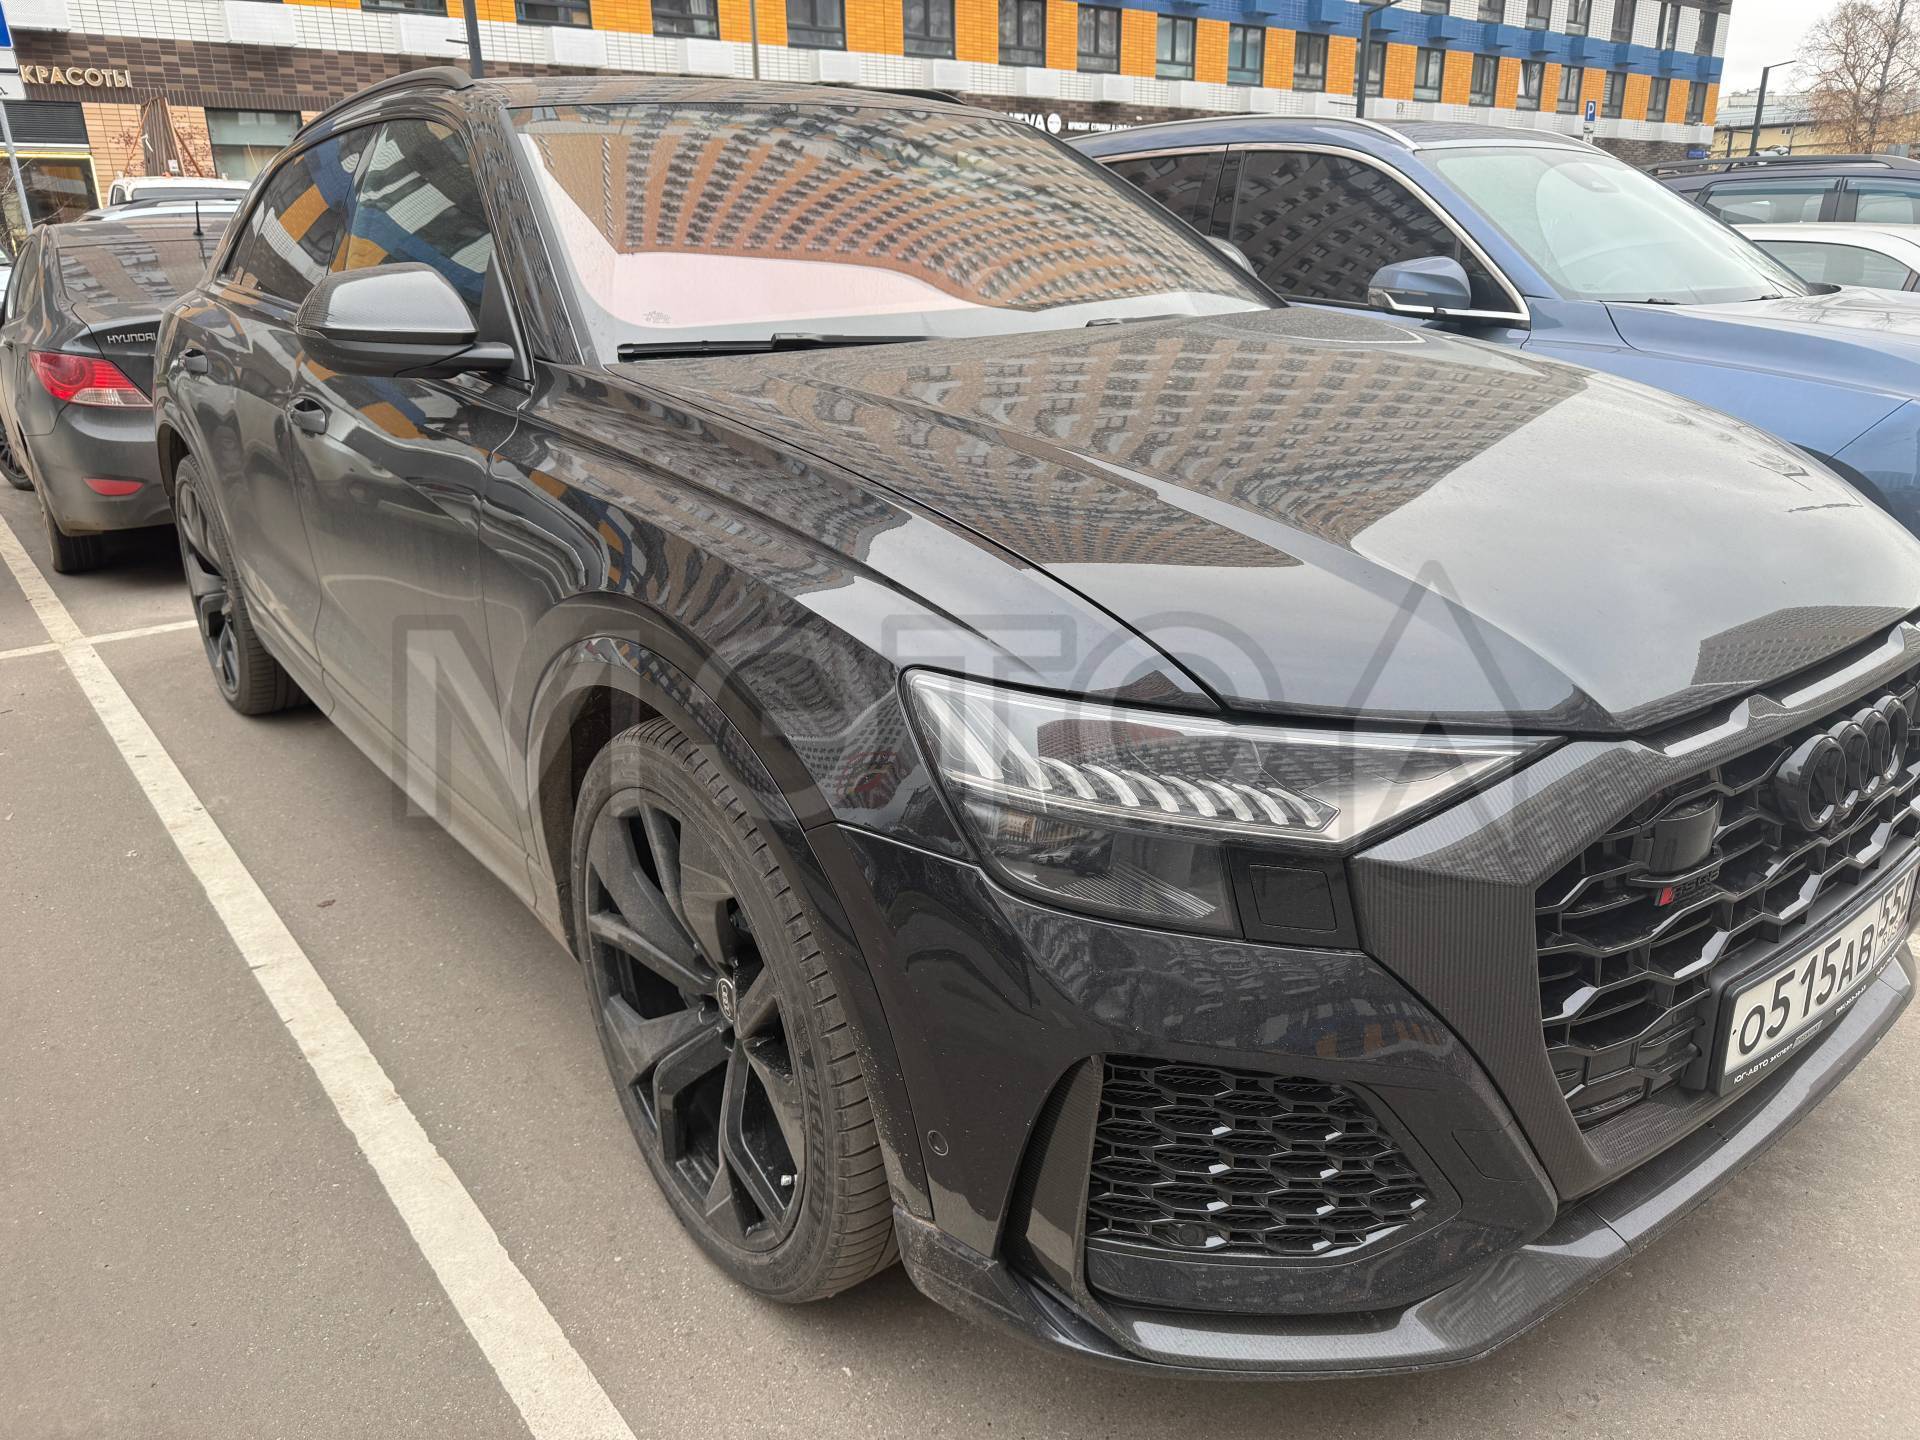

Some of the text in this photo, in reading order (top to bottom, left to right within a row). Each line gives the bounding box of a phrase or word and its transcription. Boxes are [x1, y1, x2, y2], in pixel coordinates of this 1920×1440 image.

[20, 65, 133, 88] КРАСОТЫ
[1587, 102, 1595, 120] P
[107, 332, 156, 344] HYUNDAI
[1734, 1058, 1769, 1085] ЮГ-АВТО
